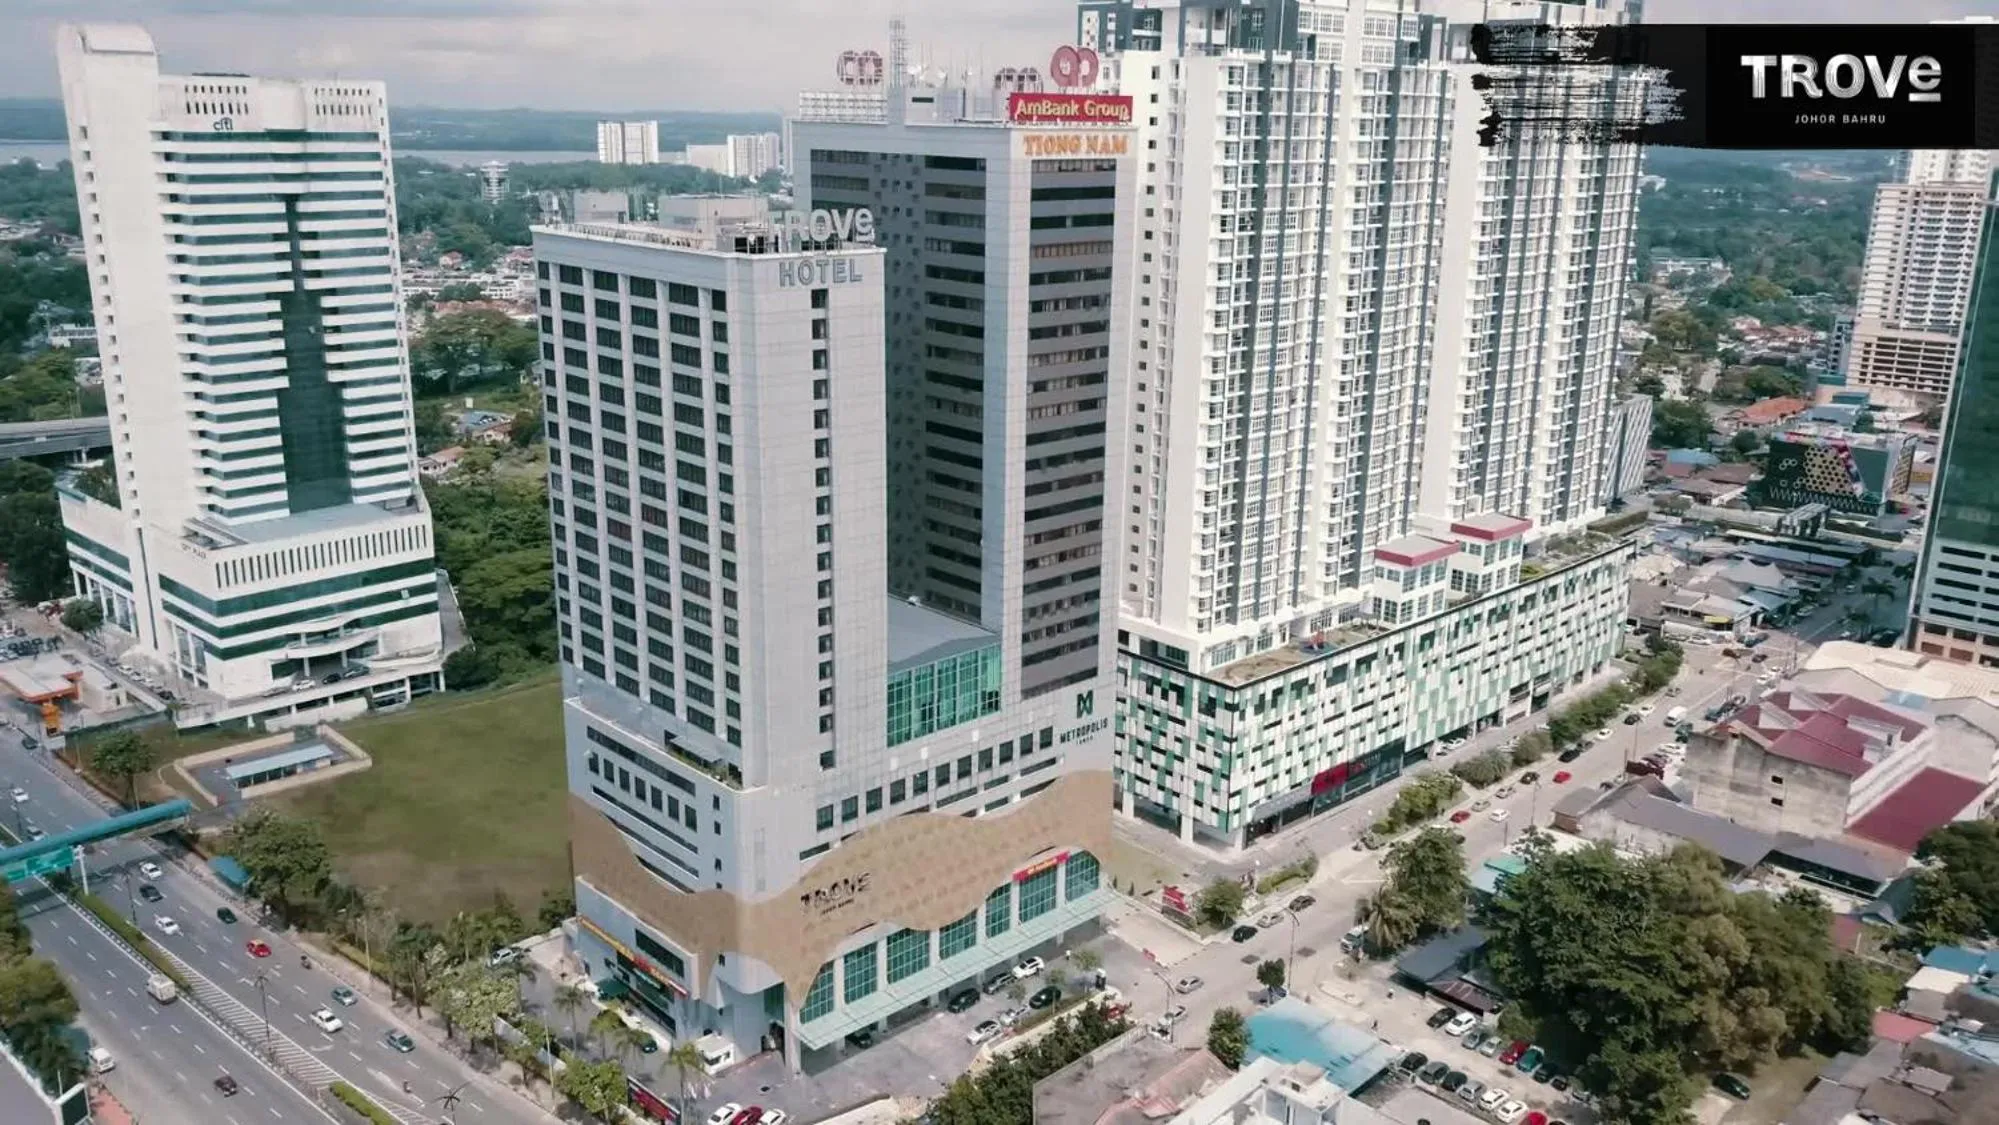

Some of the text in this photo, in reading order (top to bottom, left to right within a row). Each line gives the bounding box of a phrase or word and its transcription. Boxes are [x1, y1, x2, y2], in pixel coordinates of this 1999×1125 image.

[1015, 98, 1130, 121] AmBank Group
[1023, 133, 1129, 156] TIONG NAM
[779, 257, 863, 287] HOTEL
[1060, 717, 1108, 744] METROPOLIS
